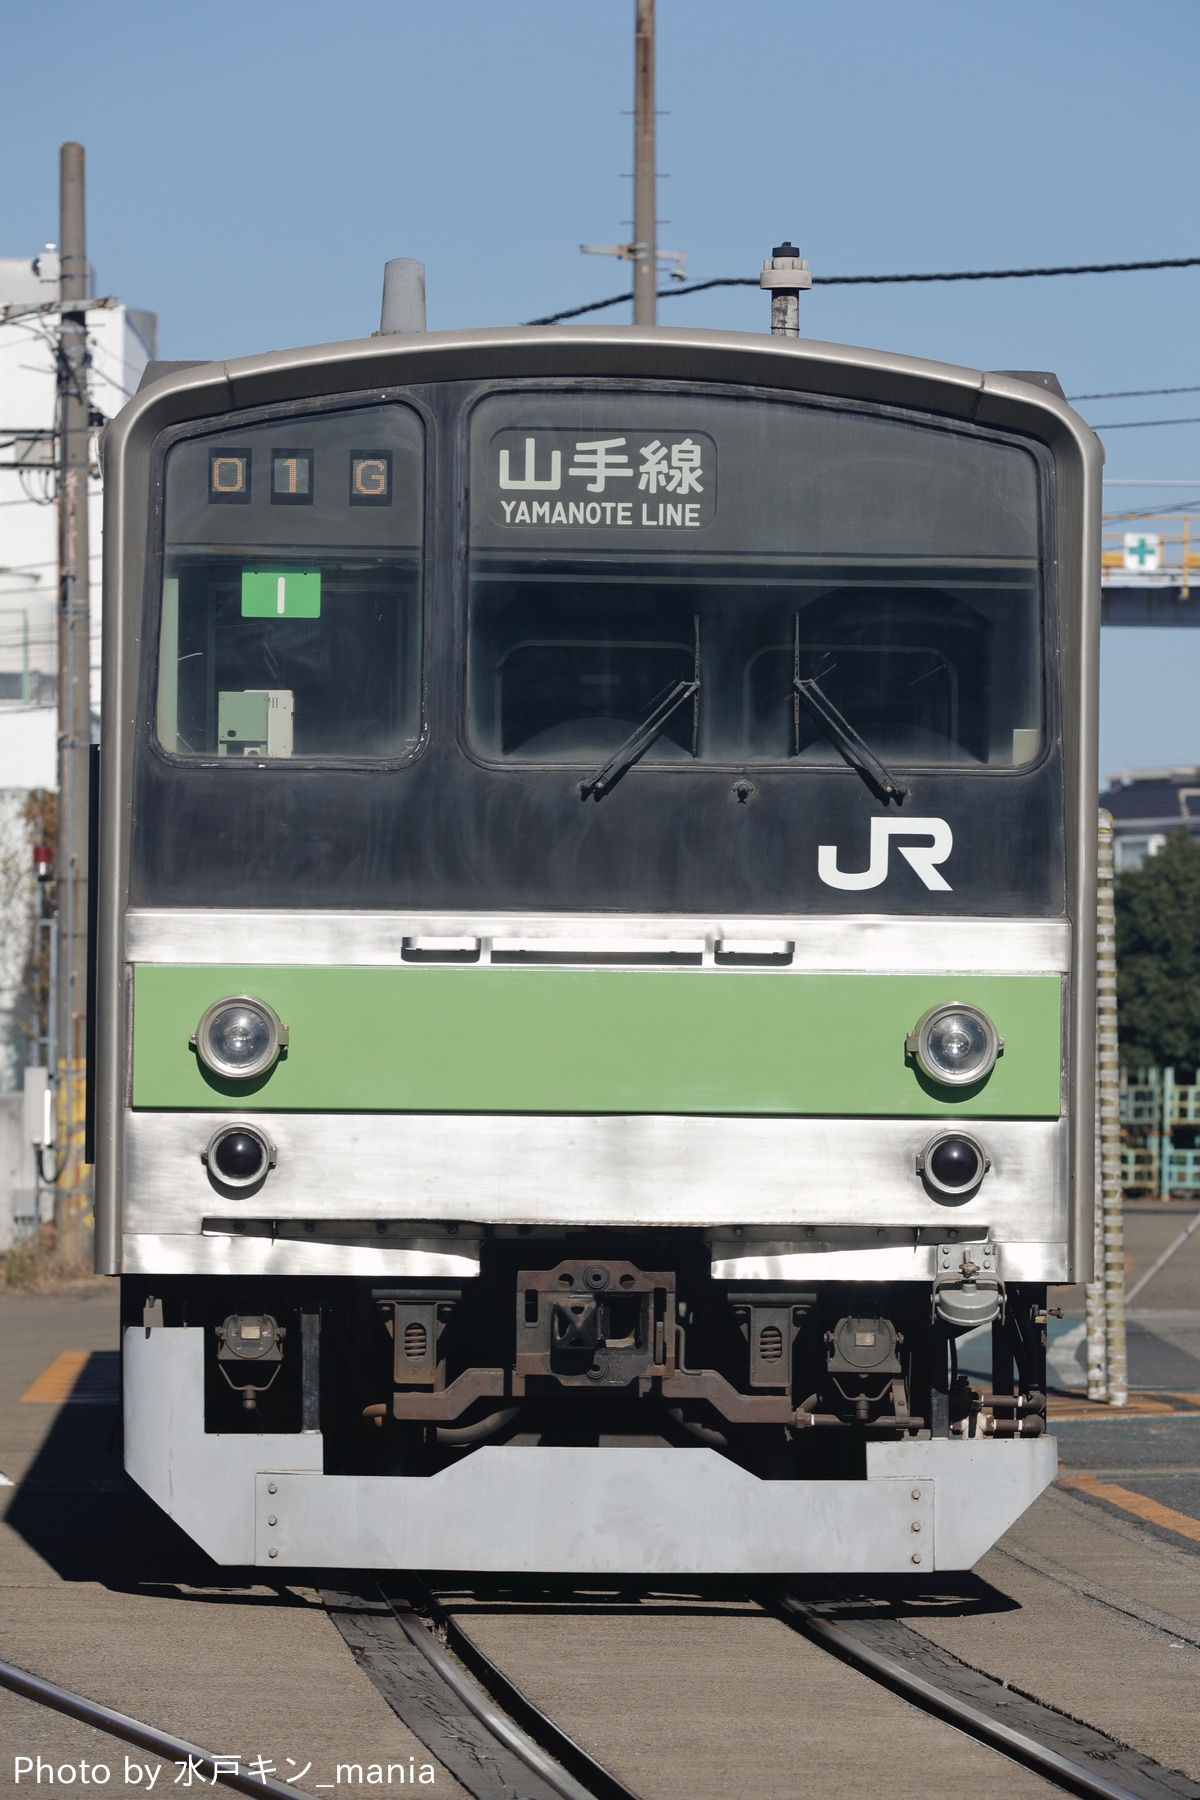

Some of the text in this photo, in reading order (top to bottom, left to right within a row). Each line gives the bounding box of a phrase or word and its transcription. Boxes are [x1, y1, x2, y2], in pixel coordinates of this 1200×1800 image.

[500, 437, 704, 494] 山手線
[500, 500, 701, 526] YAMANOTE LINE
[818, 817, 954, 891] JR
